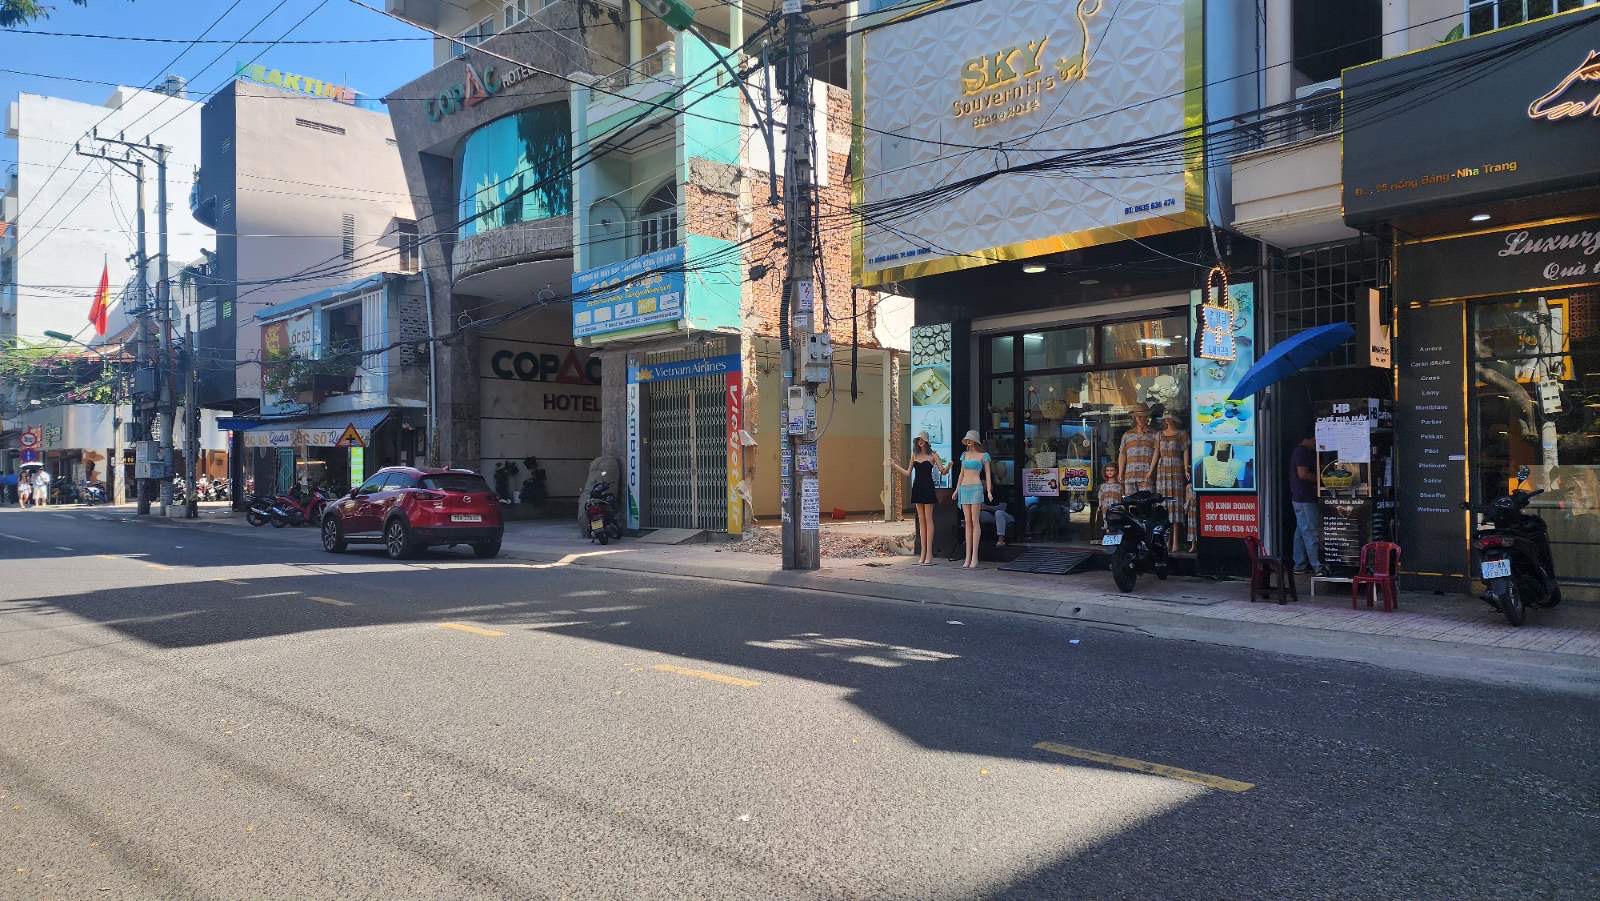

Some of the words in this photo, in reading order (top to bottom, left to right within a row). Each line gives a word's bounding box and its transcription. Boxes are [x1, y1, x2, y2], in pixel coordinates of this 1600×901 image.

[961, 35, 1049, 96] SKY
[423, 63, 501, 122] COPAC
[952, 75, 1056, 119] Souvernirs
[1457, 168, 1479, 178] Nha
[1482, 160, 1517, 173] Trang
[1543, 261, 1587, 280] Quà
[655, 365, 692, 378] Vietnam
[692, 359, 727, 374] Airlines
[543, 393, 601, 413] HOTEL
[1333, 403, 1350, 413] HB
[1215, 502, 1232, 510] KINH
[1233, 502, 1256, 510] DOANH
[1205, 513, 1218, 521] SKY
